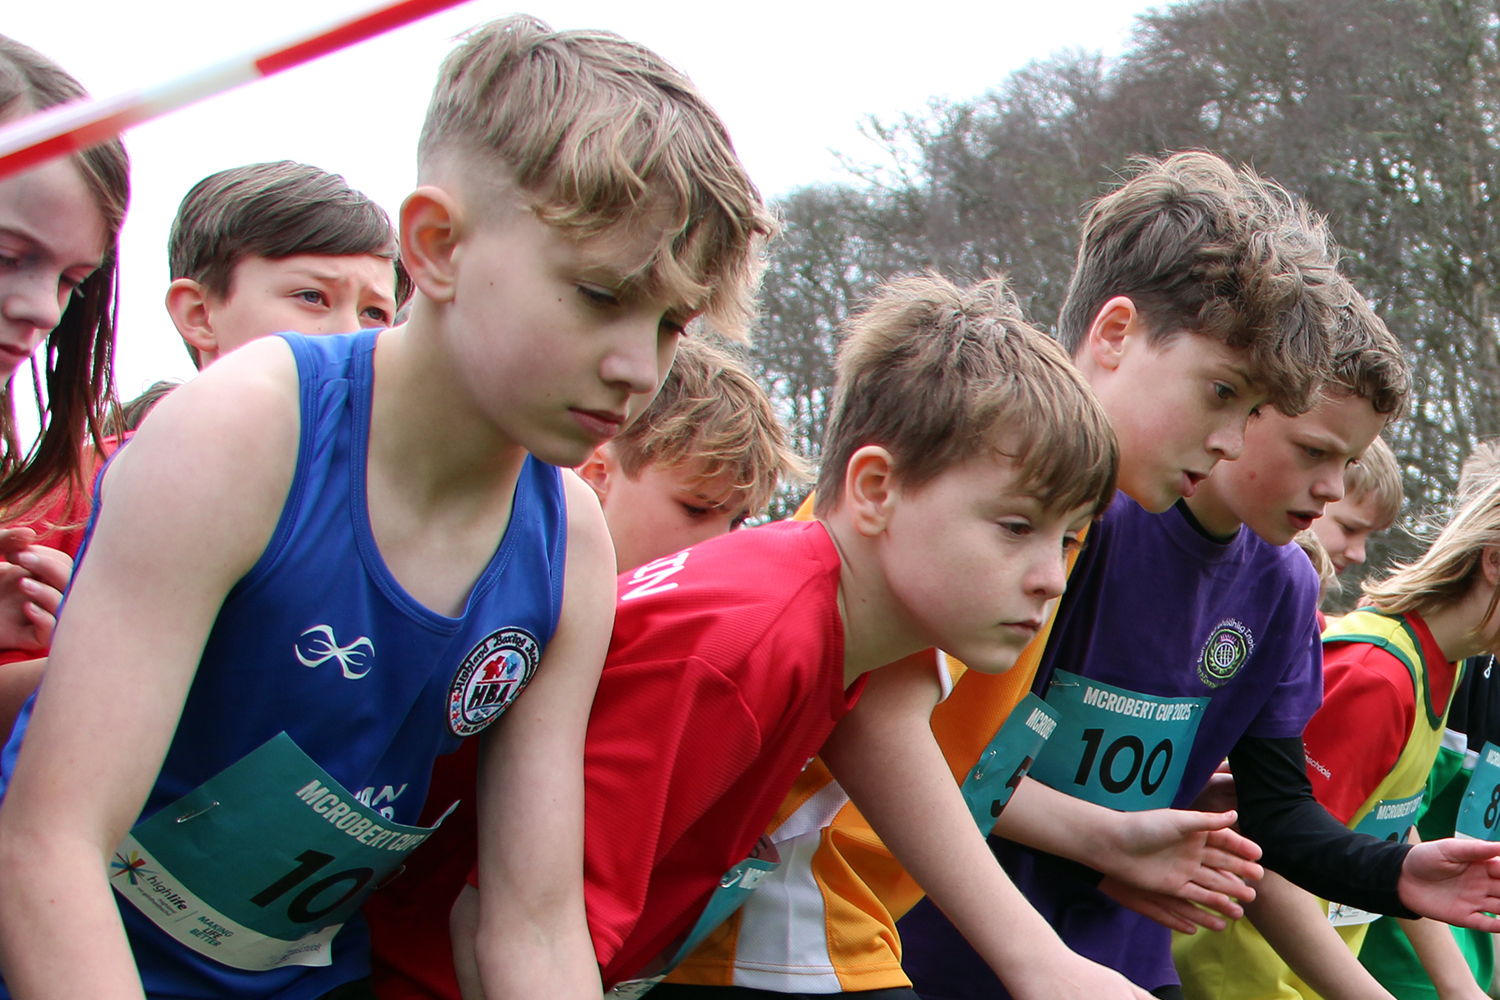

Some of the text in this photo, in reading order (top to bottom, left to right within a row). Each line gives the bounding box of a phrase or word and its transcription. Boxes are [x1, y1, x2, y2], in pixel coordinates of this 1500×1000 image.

[467, 684, 512, 711] HBA
[1082, 686, 1194, 721] MCROBERT CUP 2025
[1073, 728, 1174, 796] 100
[296, 779, 401, 851] MCROBERT
[146, 874, 188, 911] highlife
[189, 928, 222, 948] BETTER
[197, 915, 235, 938] MAKING
[203, 927, 224, 941] LIFE
